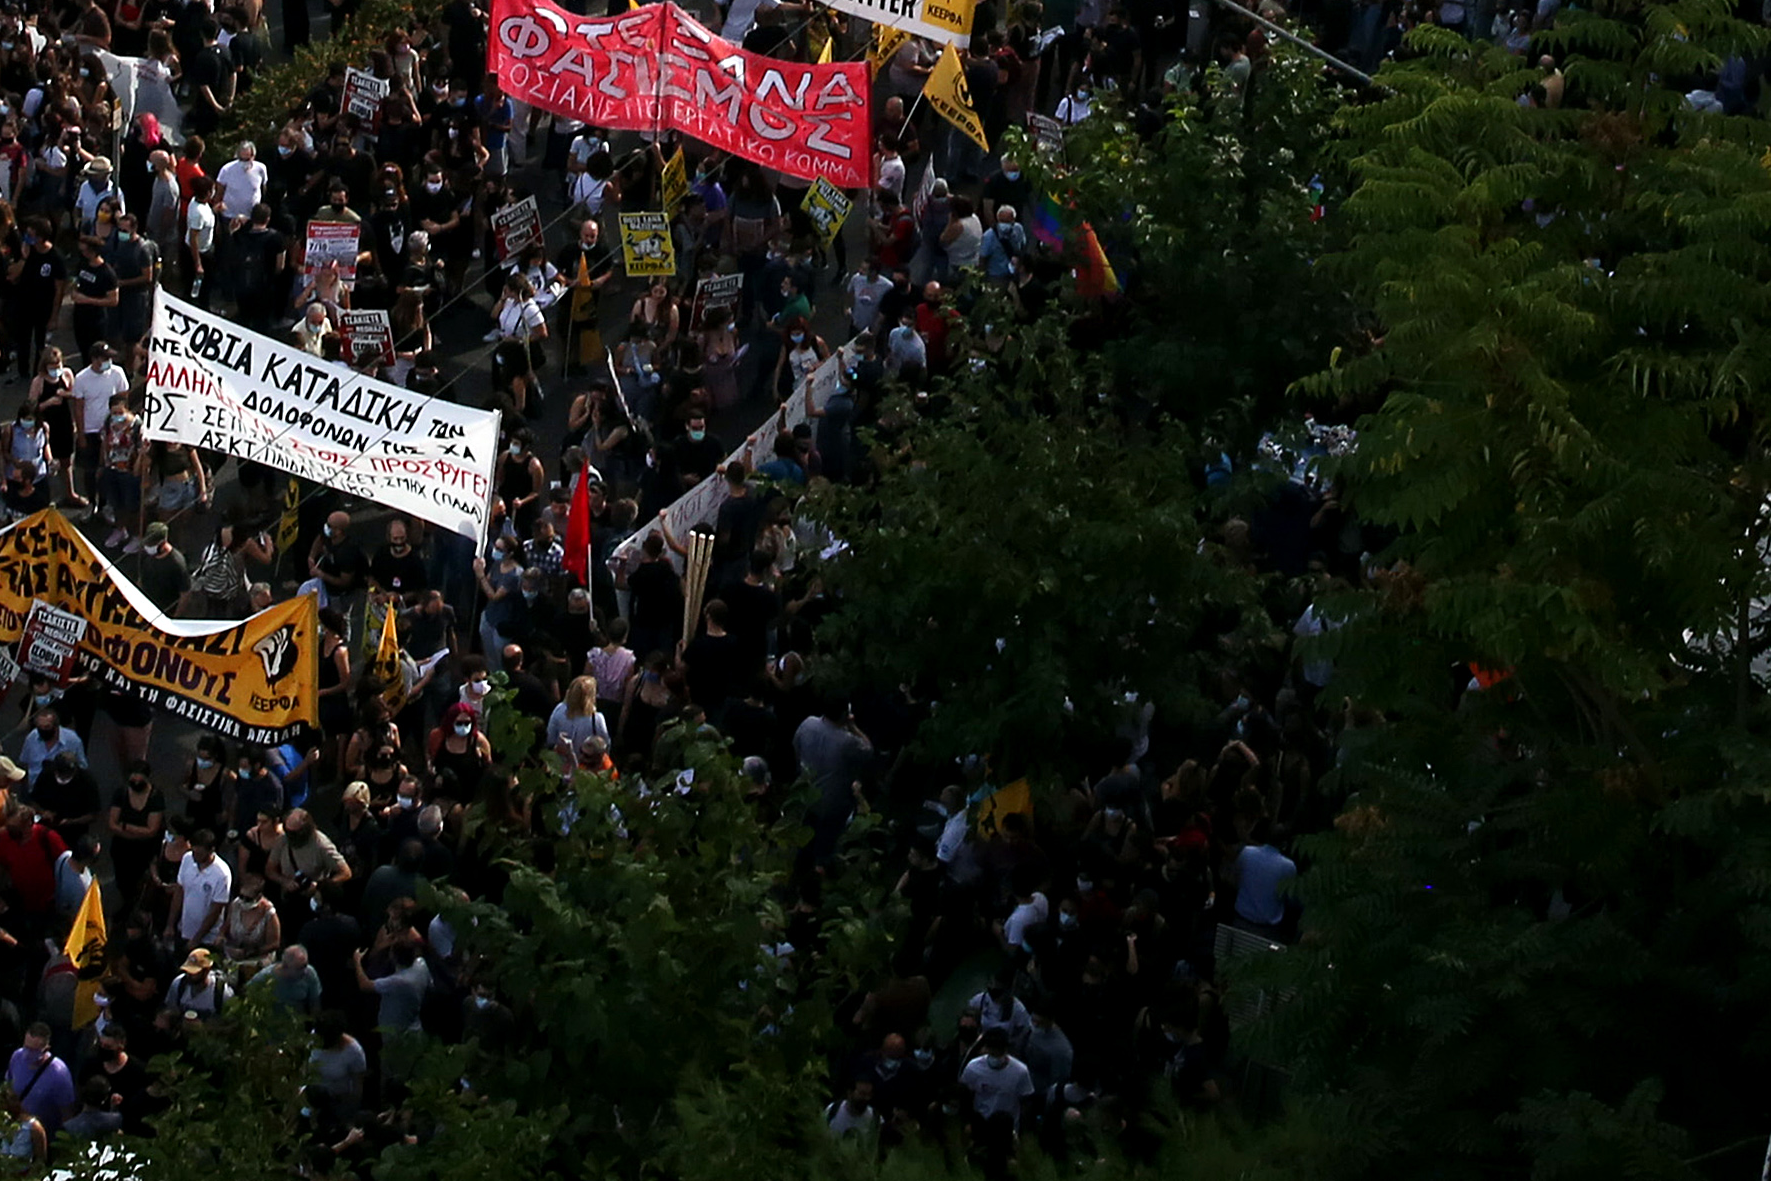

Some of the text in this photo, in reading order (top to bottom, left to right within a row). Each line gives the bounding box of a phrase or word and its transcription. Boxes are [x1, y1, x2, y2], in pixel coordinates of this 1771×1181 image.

[927, 3, 964, 27] ΚΕΕΡΦΑ
[498, 15, 853, 160] ΦΑΣΙΣΜΟΣ
[673, 99, 775, 163] ΕΡΓΑΤΙΚΟ
[783, 144, 861, 183] ΚΟΜΜΑ
[930, 94, 984, 143] ΚΕΕΡΦΑ
[243, 390, 370, 454] ΔΟΛΟΦΟΝΩΝ
[260, 351, 425, 437] ΚΑΤΑΔΙΚΗ
[427, 418, 466, 440] ΤΩΝ
[38, 609, 76, 633] ΤΣΑΚΙΣΤΕ
[138, 685, 159, 704] ΤΗ
[165, 695, 241, 738] ΦΑΣΙΣΤΙΚΗ
